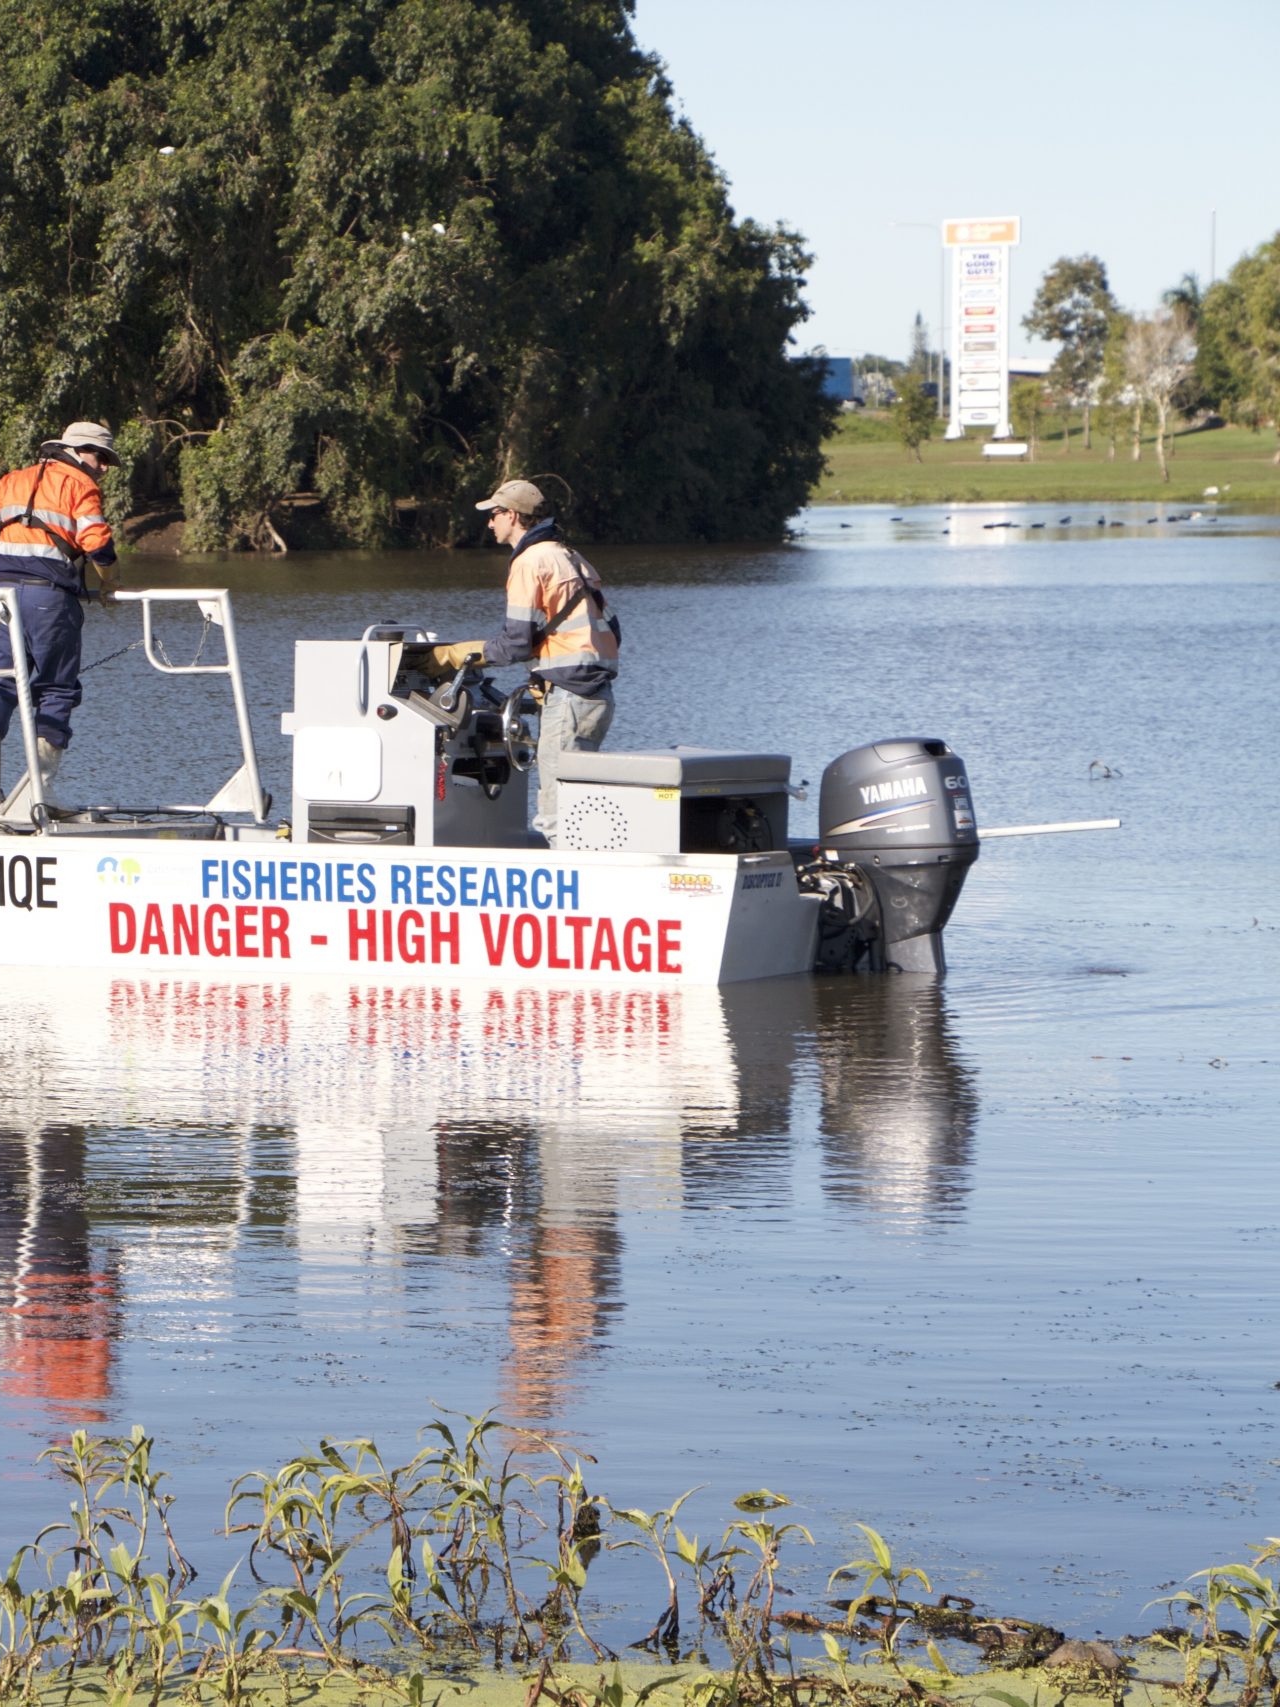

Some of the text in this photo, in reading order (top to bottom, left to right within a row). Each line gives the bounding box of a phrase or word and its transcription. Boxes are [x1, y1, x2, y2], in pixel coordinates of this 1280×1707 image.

[860, 776, 928, 805] YAMAHA
[944, 775, 969, 790] 60
[202, 859, 579, 910] FISHERIES RESEARCH
[109, 902, 682, 974] DANGER - HIGH VOLTAGE
